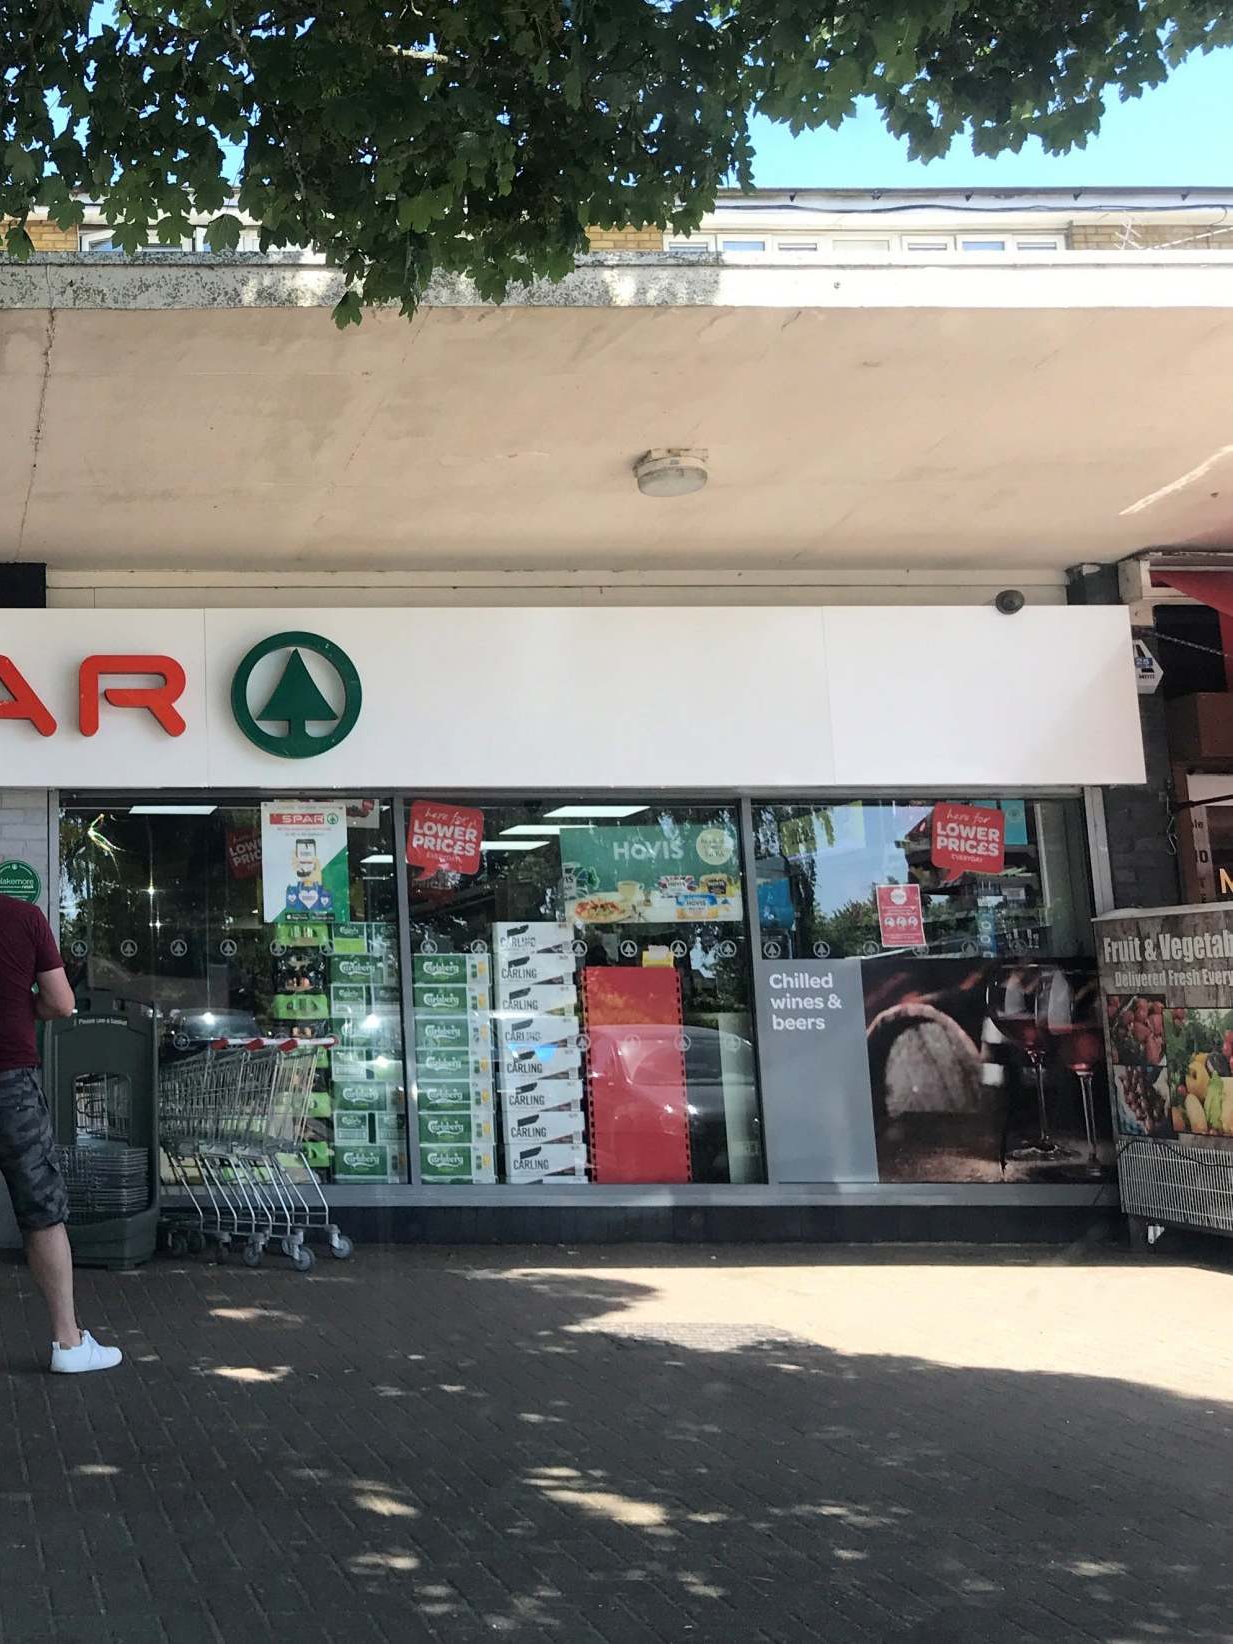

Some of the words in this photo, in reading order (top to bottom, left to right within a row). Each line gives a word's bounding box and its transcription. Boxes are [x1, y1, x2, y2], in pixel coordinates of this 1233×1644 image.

[281, 814, 324, 824] SPAR
[414, 819, 478, 842] LOWER
[936, 821, 1000, 842] LOWER
[612, 840, 684, 861] HOVIS
[1103, 936, 1142, 963] Fruit
[1145, 938, 1157, 961] &
[423, 961, 459, 976] Carlsberg
[501, 968, 537, 979] CARLING
[769, 972, 833, 989] Chilled
[1114, 969, 1167, 987] Delivered
[1168, 969, 1201, 986] Fresh
[423, 993, 459, 1007] Carlsberg
[502, 1000, 539, 1010] CARLING
[770, 993, 824, 1009] wines
[827, 993, 842, 1009] &
[773, 1014, 825, 1030] beers
[507, 1063, 543, 1074] CARLING
[509, 1095, 545, 1106] CARLING
[427, 1120, 464, 1135] Carlsberg
[511, 1127, 547, 1138] CARLING
[427, 1152, 464, 1167] Carlsberg
[513, 1159, 549, 1170] CARLING
